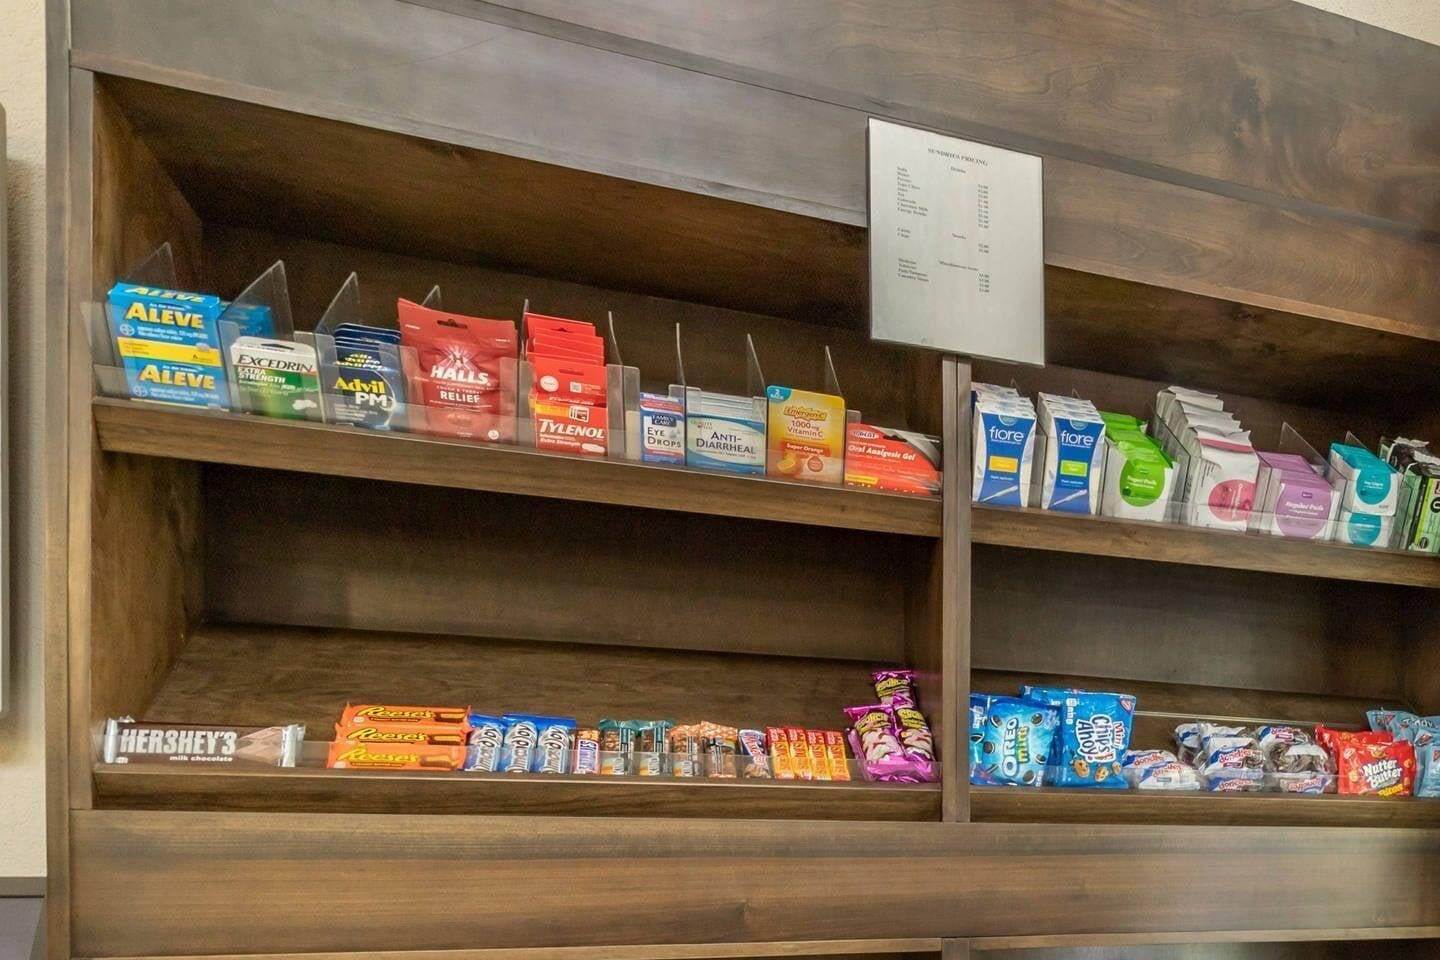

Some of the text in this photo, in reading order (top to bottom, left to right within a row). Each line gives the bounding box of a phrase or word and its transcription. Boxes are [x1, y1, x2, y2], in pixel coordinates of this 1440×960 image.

[125, 302, 204, 328] ALEVE
[237, 353, 315, 373] EXCEDRIN
[139, 364, 215, 390] ALEVE
[238, 366, 266, 377] EXTRA
[238, 372, 286, 384] STRENGTH
[431, 364, 489, 385] HALLS
[334, 377, 386, 395] Advil
[356, 392, 387, 406] PM
[440, 390, 481, 404] RELIEF
[539, 419, 605, 439] TYLENOL
[648, 427, 664, 437] EYE
[711, 432, 742, 442] ANTI-
[788, 427, 817, 436] Vitamin
[989, 426, 1024, 442] fiore
[648, 437, 681, 448] DROPS
[696, 438, 756, 454] DIARRHEAL
[1061, 430, 1094, 446] fiore
[786, 443, 823, 454] Super Orange
[1091, 715, 1111, 754] Chips
[1003, 718, 1018, 776] OREO
[1363, 759, 1397, 776] Nutter
[1371, 768, 1401, 788] Butter
